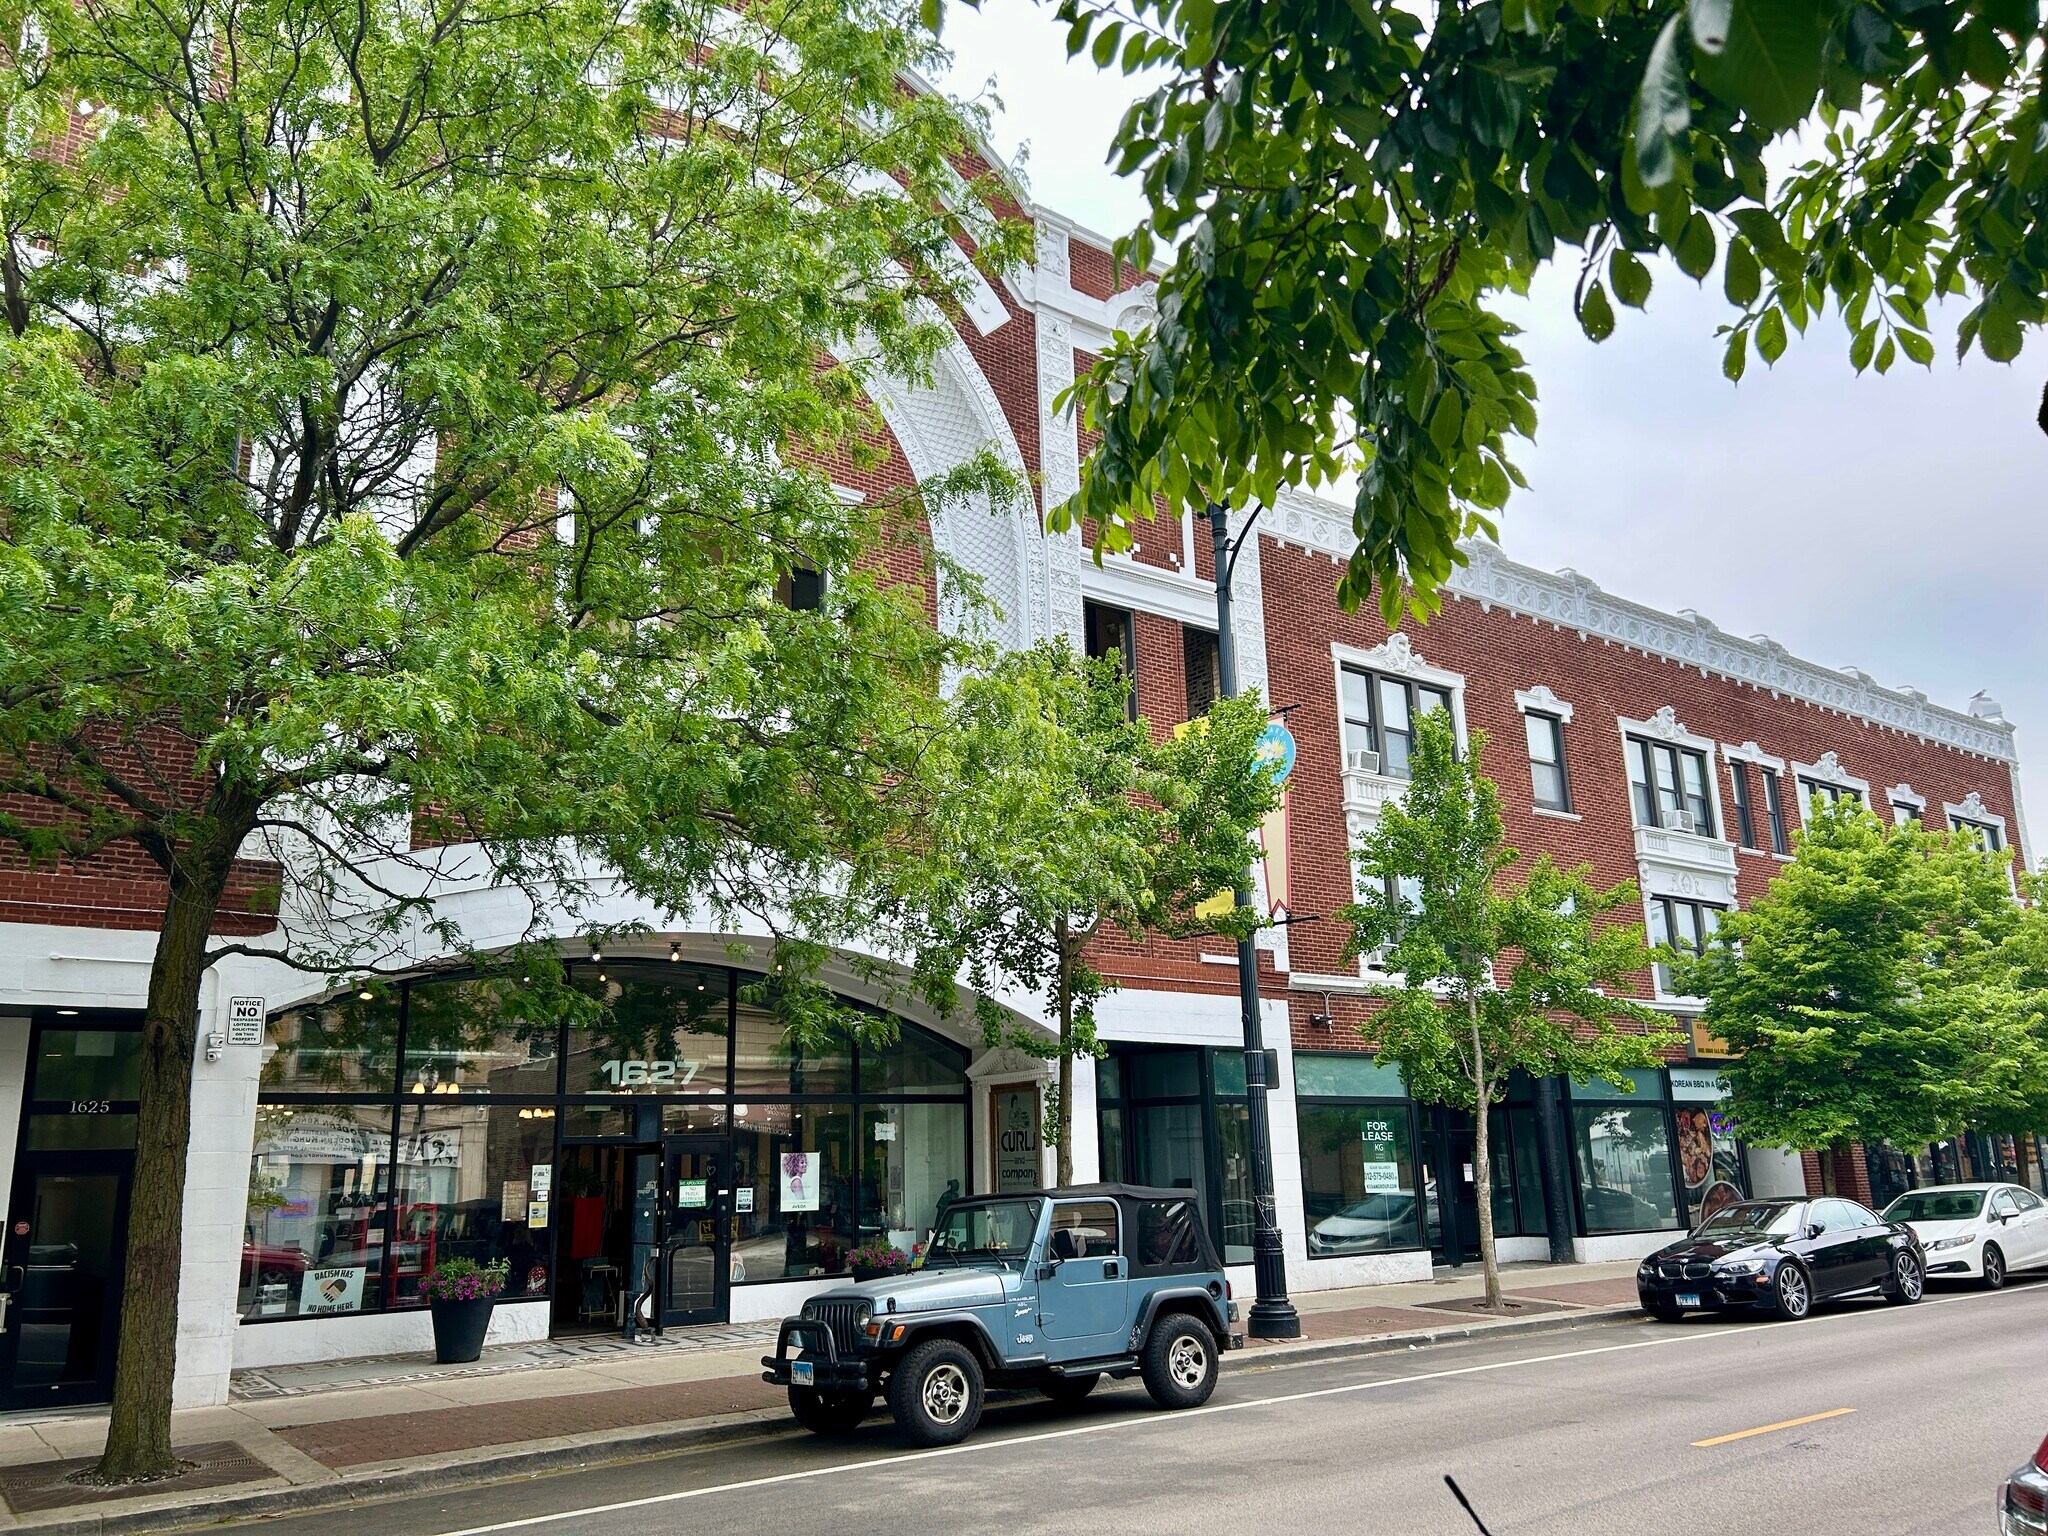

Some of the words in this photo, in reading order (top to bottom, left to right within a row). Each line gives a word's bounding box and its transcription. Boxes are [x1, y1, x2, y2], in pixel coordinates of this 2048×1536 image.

[236, 1007, 257, 1017] NO
[600, 1060, 700, 1085] 1627
[1672, 1080, 1692, 1088] KOREAN
[1693, 1080, 1705, 1088] BBQ
[69, 1100, 110, 1113] 1625
[1367, 1121, 1388, 1131] FOR
[1362, 1131, 1394, 1141] LEASE
[1374, 1143, 1384, 1151] KG
[1014, 1156, 1025, 1164] and
[1002, 1169, 1036, 1180] company
[314, 1269, 340, 1281] RACISM
[340, 1269, 354, 1279] HAS
[306, 1304, 317, 1313] NO
[317, 1304, 336, 1313] HOME
[336, 1300, 354, 1311] HERE
[525, 1328, 782, 1360] HOWAR
[1015, 1333, 1034, 1344] Jeep
